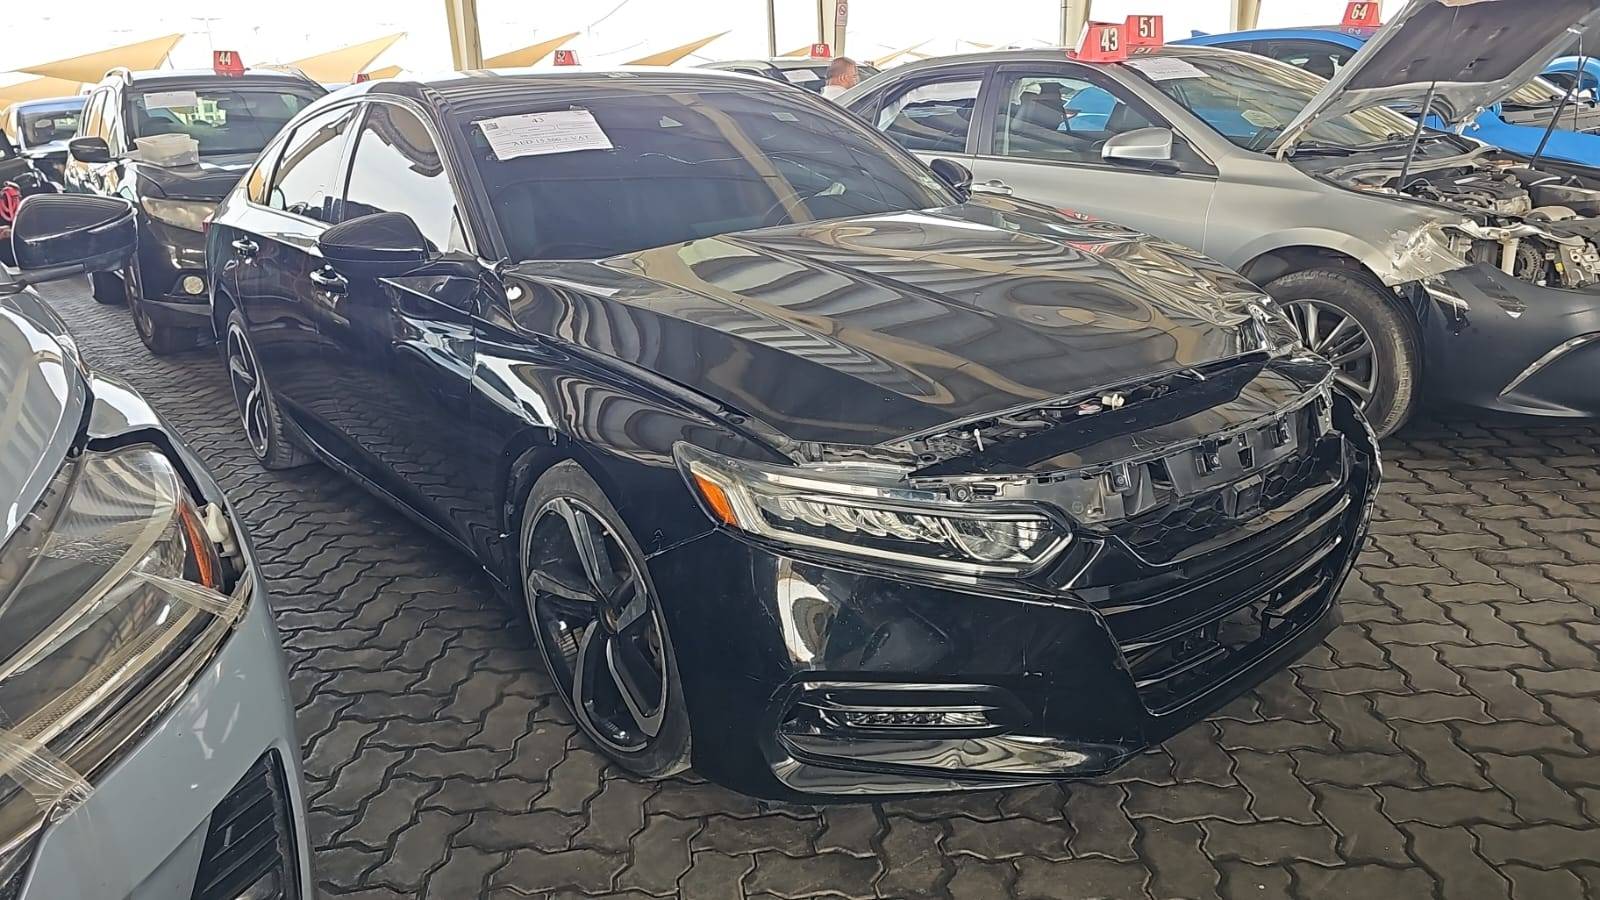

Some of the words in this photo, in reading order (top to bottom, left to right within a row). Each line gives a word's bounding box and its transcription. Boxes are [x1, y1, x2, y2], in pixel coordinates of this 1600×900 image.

[1351, 3, 1369, 20] 64
[1139, 16, 1156, 37] 51
[1101, 28, 1118, 52] 43
[219, 52, 231, 65] 44
